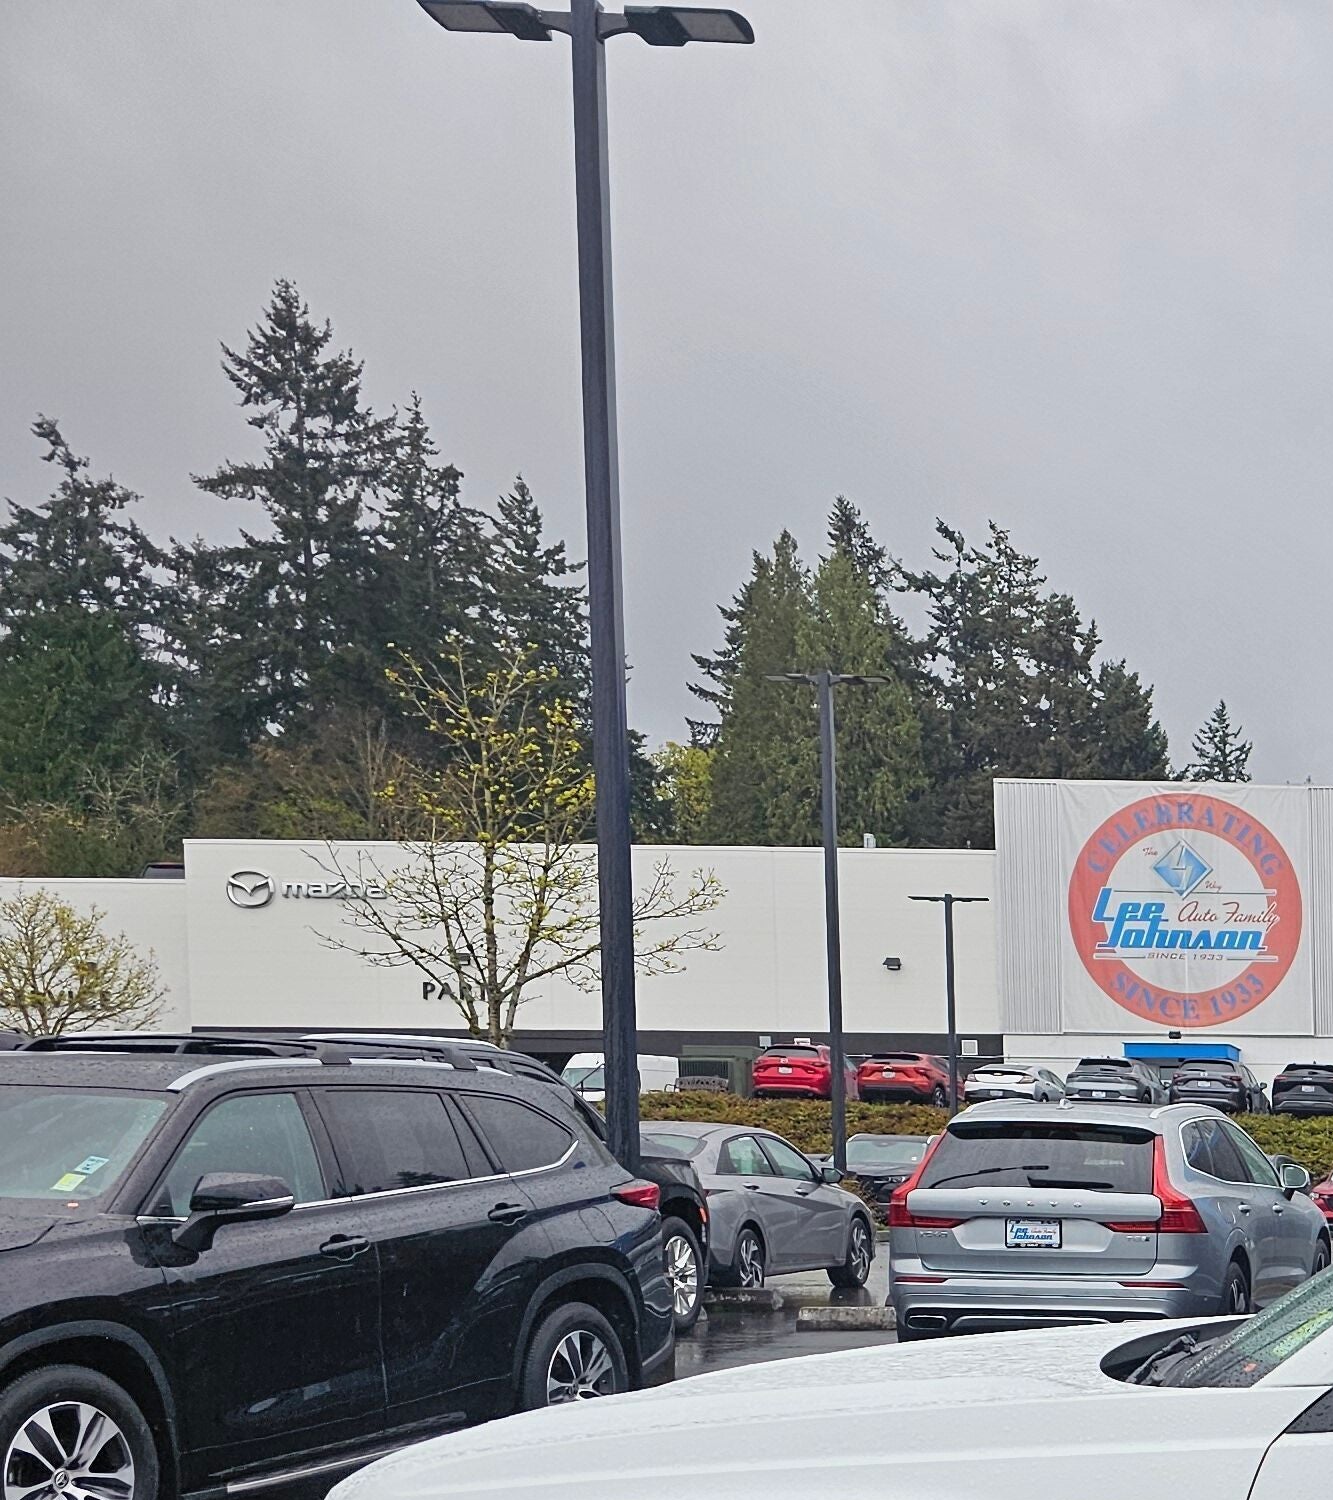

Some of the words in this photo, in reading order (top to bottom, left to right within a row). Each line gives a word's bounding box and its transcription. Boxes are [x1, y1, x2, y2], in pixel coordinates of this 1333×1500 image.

[1087, 802, 1283, 877] CELEBRATING
[1093, 887, 1168, 922] Lee
[1177, 900, 1218, 923] Auto
[1222, 901, 1280, 932] Family
[1097, 908, 1266, 951] Johnson
[1147, 952, 1185, 961] SINCE
[1192, 953, 1224, 962] 1933
[1110, 971, 1200, 1020] SINCE
[1210, 972, 1265, 1018] 1933
